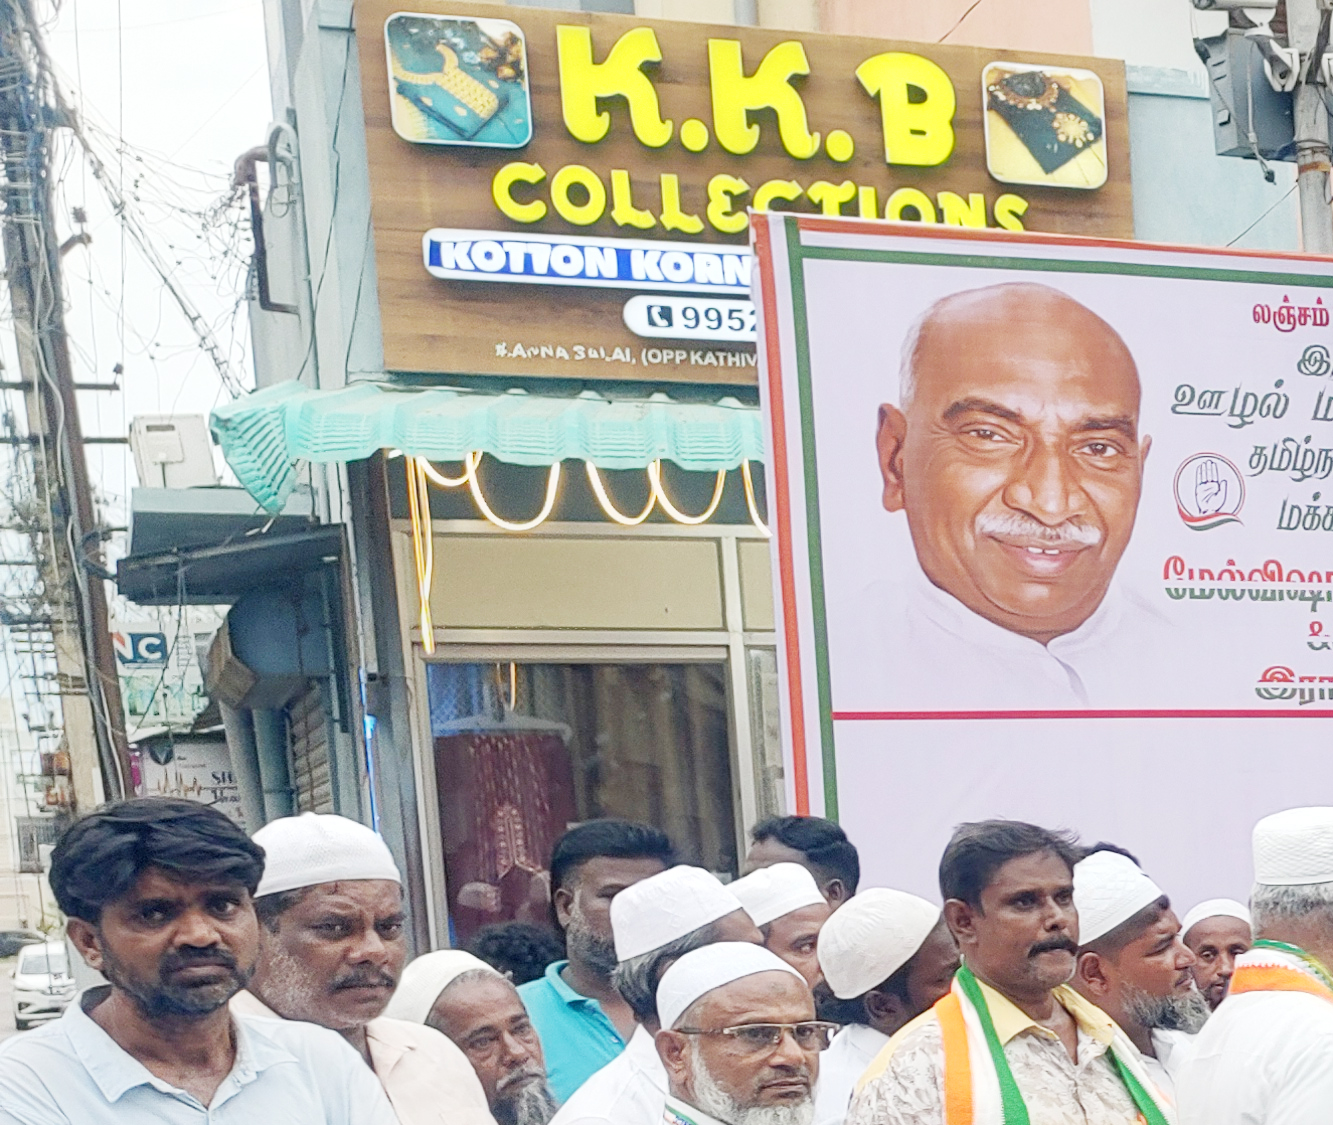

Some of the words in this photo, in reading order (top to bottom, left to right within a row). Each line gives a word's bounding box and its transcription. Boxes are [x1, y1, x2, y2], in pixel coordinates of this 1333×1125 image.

[492, 161, 1029, 234] COLLECTIONS
[1252, 295, 1330, 333] லஞ்சம்
[641, 348, 687, 366] (OPP
[1171, 379, 1290, 428] ஊழல்
